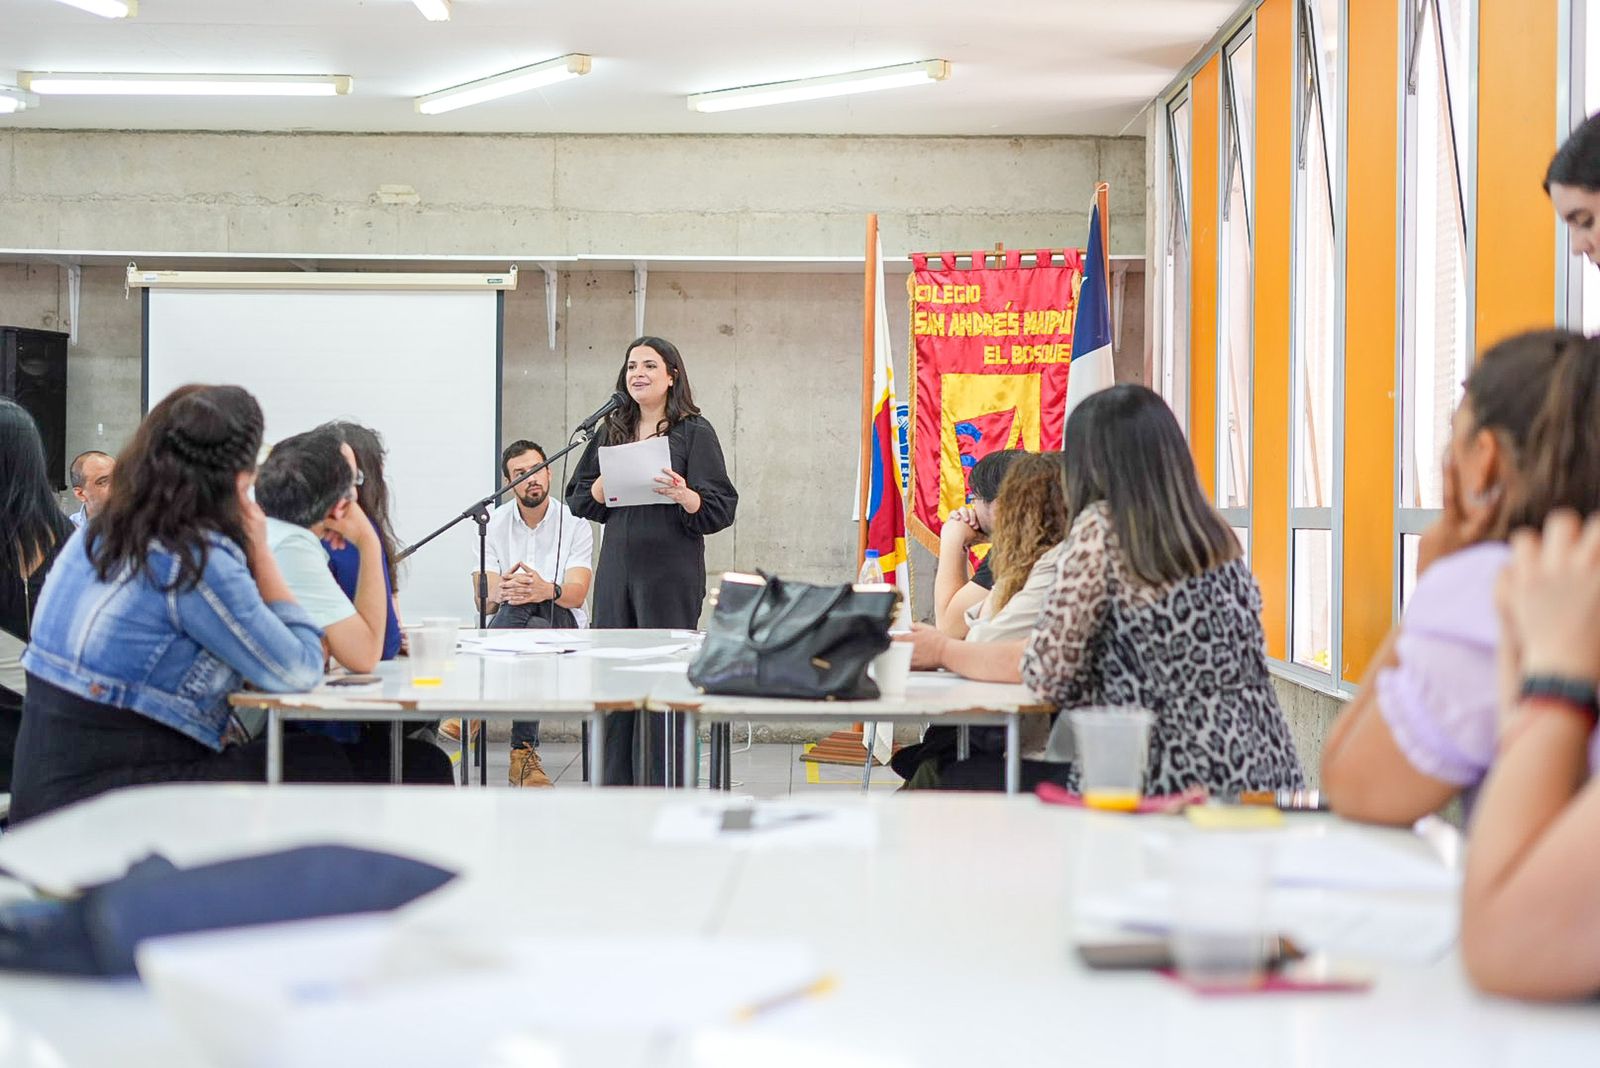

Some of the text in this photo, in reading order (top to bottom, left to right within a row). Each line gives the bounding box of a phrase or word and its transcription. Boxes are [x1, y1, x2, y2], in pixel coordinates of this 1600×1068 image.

[914, 301, 1074, 337] SAN ANDRÉS MAIPÚ
[984, 343, 1071, 365] EL BOSQUE
